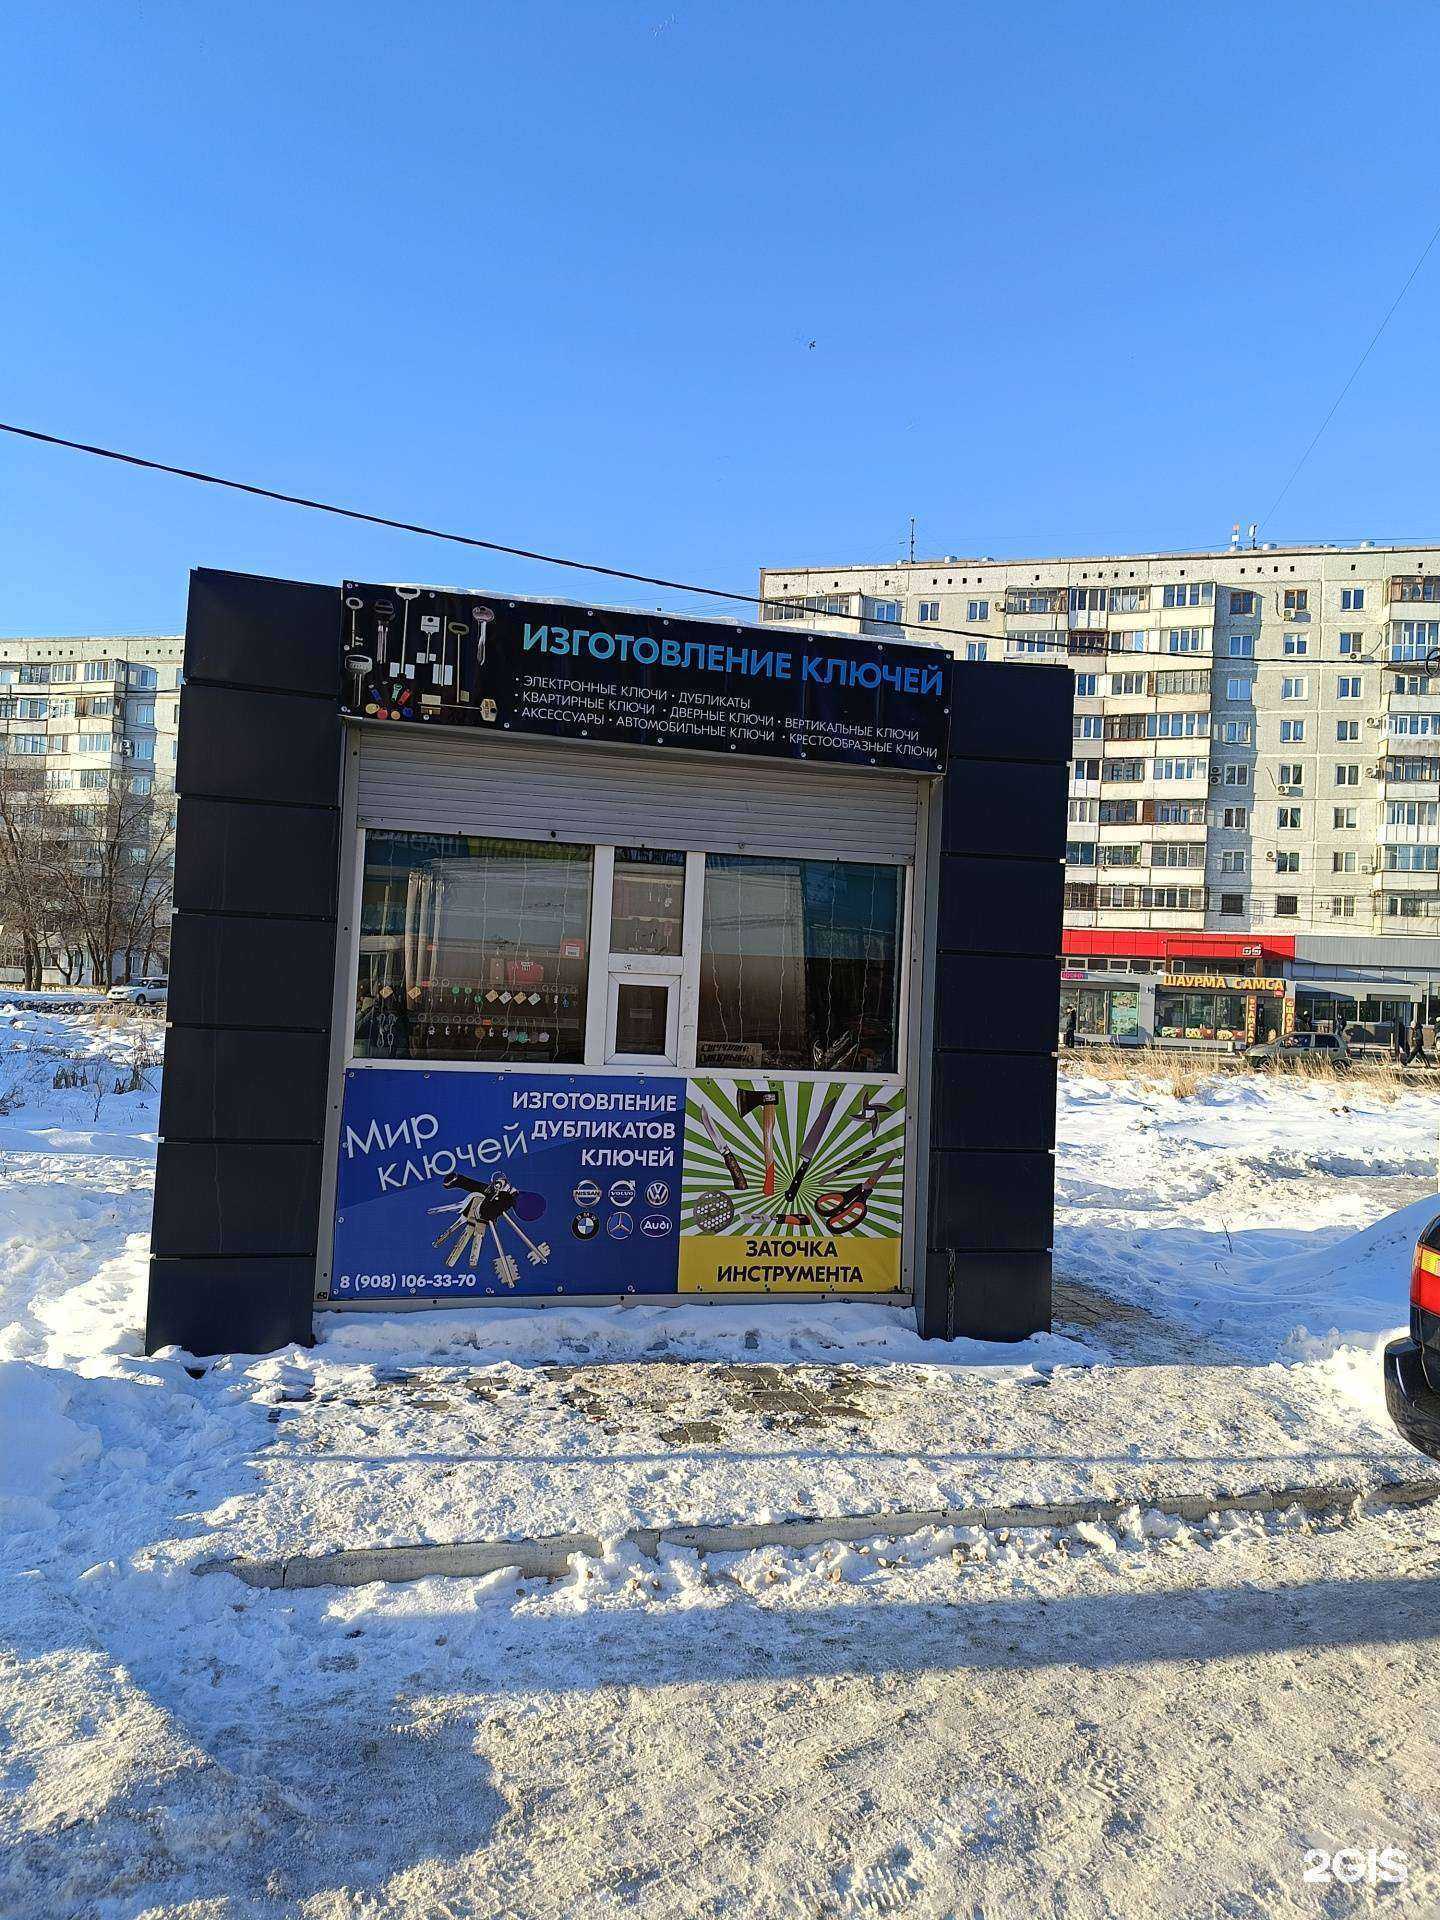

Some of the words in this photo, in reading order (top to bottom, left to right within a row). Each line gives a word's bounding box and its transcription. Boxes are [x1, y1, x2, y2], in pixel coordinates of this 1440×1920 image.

[522, 623, 792, 680] ИЗГОТОВЛЕНИЕ
[802, 655, 944, 697] КЛЮЧЕЙ
[523, 675, 617, 696] ЭЛЕКТРОННЫЕ
[621, 686, 668, 701] КЛЮЧИ
[522, 691, 605, 710] КВАРТИРНЫЕ
[608, 700, 656, 715] КЛЮЧИ
[679, 692, 751, 710] ДУБЛИКАТЫ
[521, 706, 605, 726] АКСЕССУАРЫ
[670, 706, 726, 722] ДВЕРНЫЕ
[729, 712, 775, 727] КЛЮЧИ
[616, 716, 726, 738] АВТОМОБИЛЬНЫЕ
[729, 727, 775, 742] КЛЮЧИ
[785, 718, 873, 738] ВЕРТИКАЛЬНЫЕ
[876, 726, 920, 742] КЛЮЧИ
[789, 733, 892, 754] КРЕСТООБРАЗНЫЕ
[895, 744, 938, 759] КЛЮЧИ
[1163, 975, 1227, 989] ШАУРМА
[1232, 978, 1285, 991] САМСА
[512, 1091, 677, 1112] ИЗГОТОВЛЕНИЕ
[346, 1113, 439, 1159] Мир
[531, 1120, 676, 1140] ДУБЛИКАТОВ
[377, 1122, 528, 1191] ключей
[581, 1147, 674, 1167] КЛЮЧЕЙ
[575, 1189, 600, 1197] NISSAN
[643, 1221, 670, 1230] Audi
[745, 1240, 838, 1258] ЗАТОЧКА
[339, 1275, 350, 1289] 8
[354, 1273, 397, 1292] (908)
[401, 1274, 477, 1288] 106-33-70
[717, 1265, 864, 1283] ИНСТРУМЕНТА
